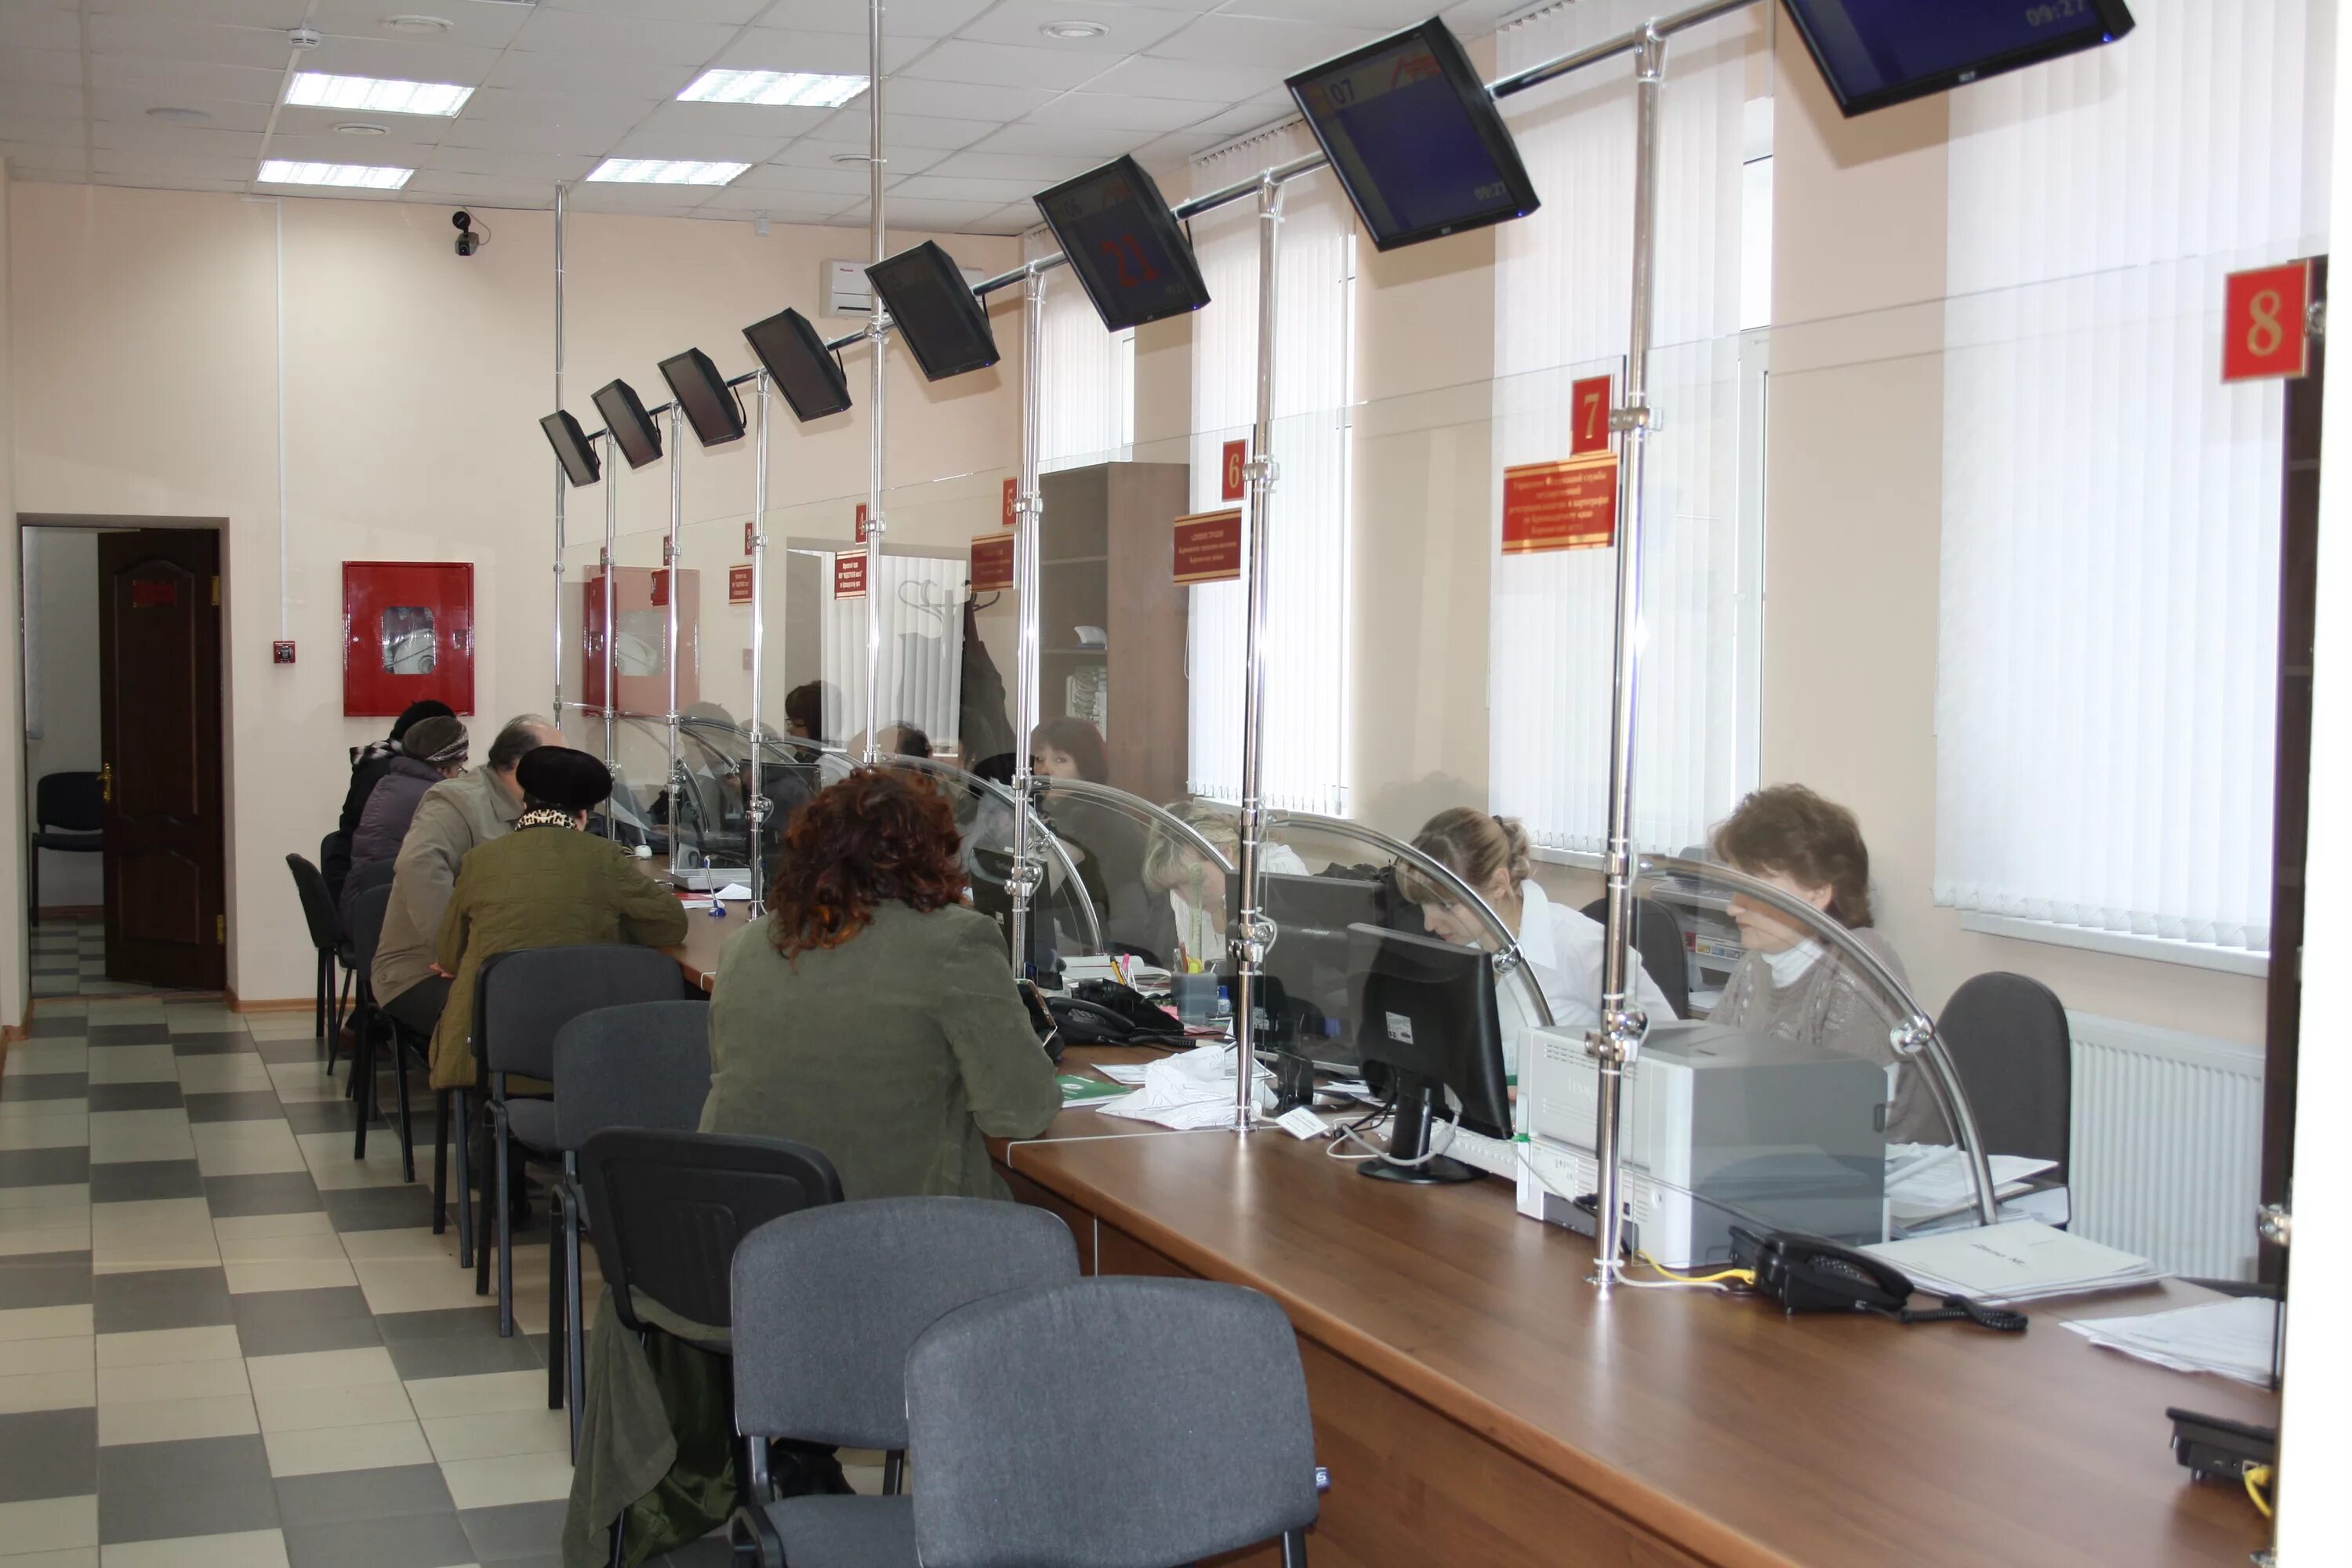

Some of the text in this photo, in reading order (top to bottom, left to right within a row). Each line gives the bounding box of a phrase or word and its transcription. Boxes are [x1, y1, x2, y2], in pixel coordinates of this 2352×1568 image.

[2026, 0, 2086, 27] 09:27
[1330, 78, 1355, 105] 07
[2247, 289, 2281, 356] 8
[1584, 393, 1600, 439] 7
[1229, 453, 1239, 488] 6
[1007, 488, 1013, 516] 5
[858, 512, 865, 535] 4
